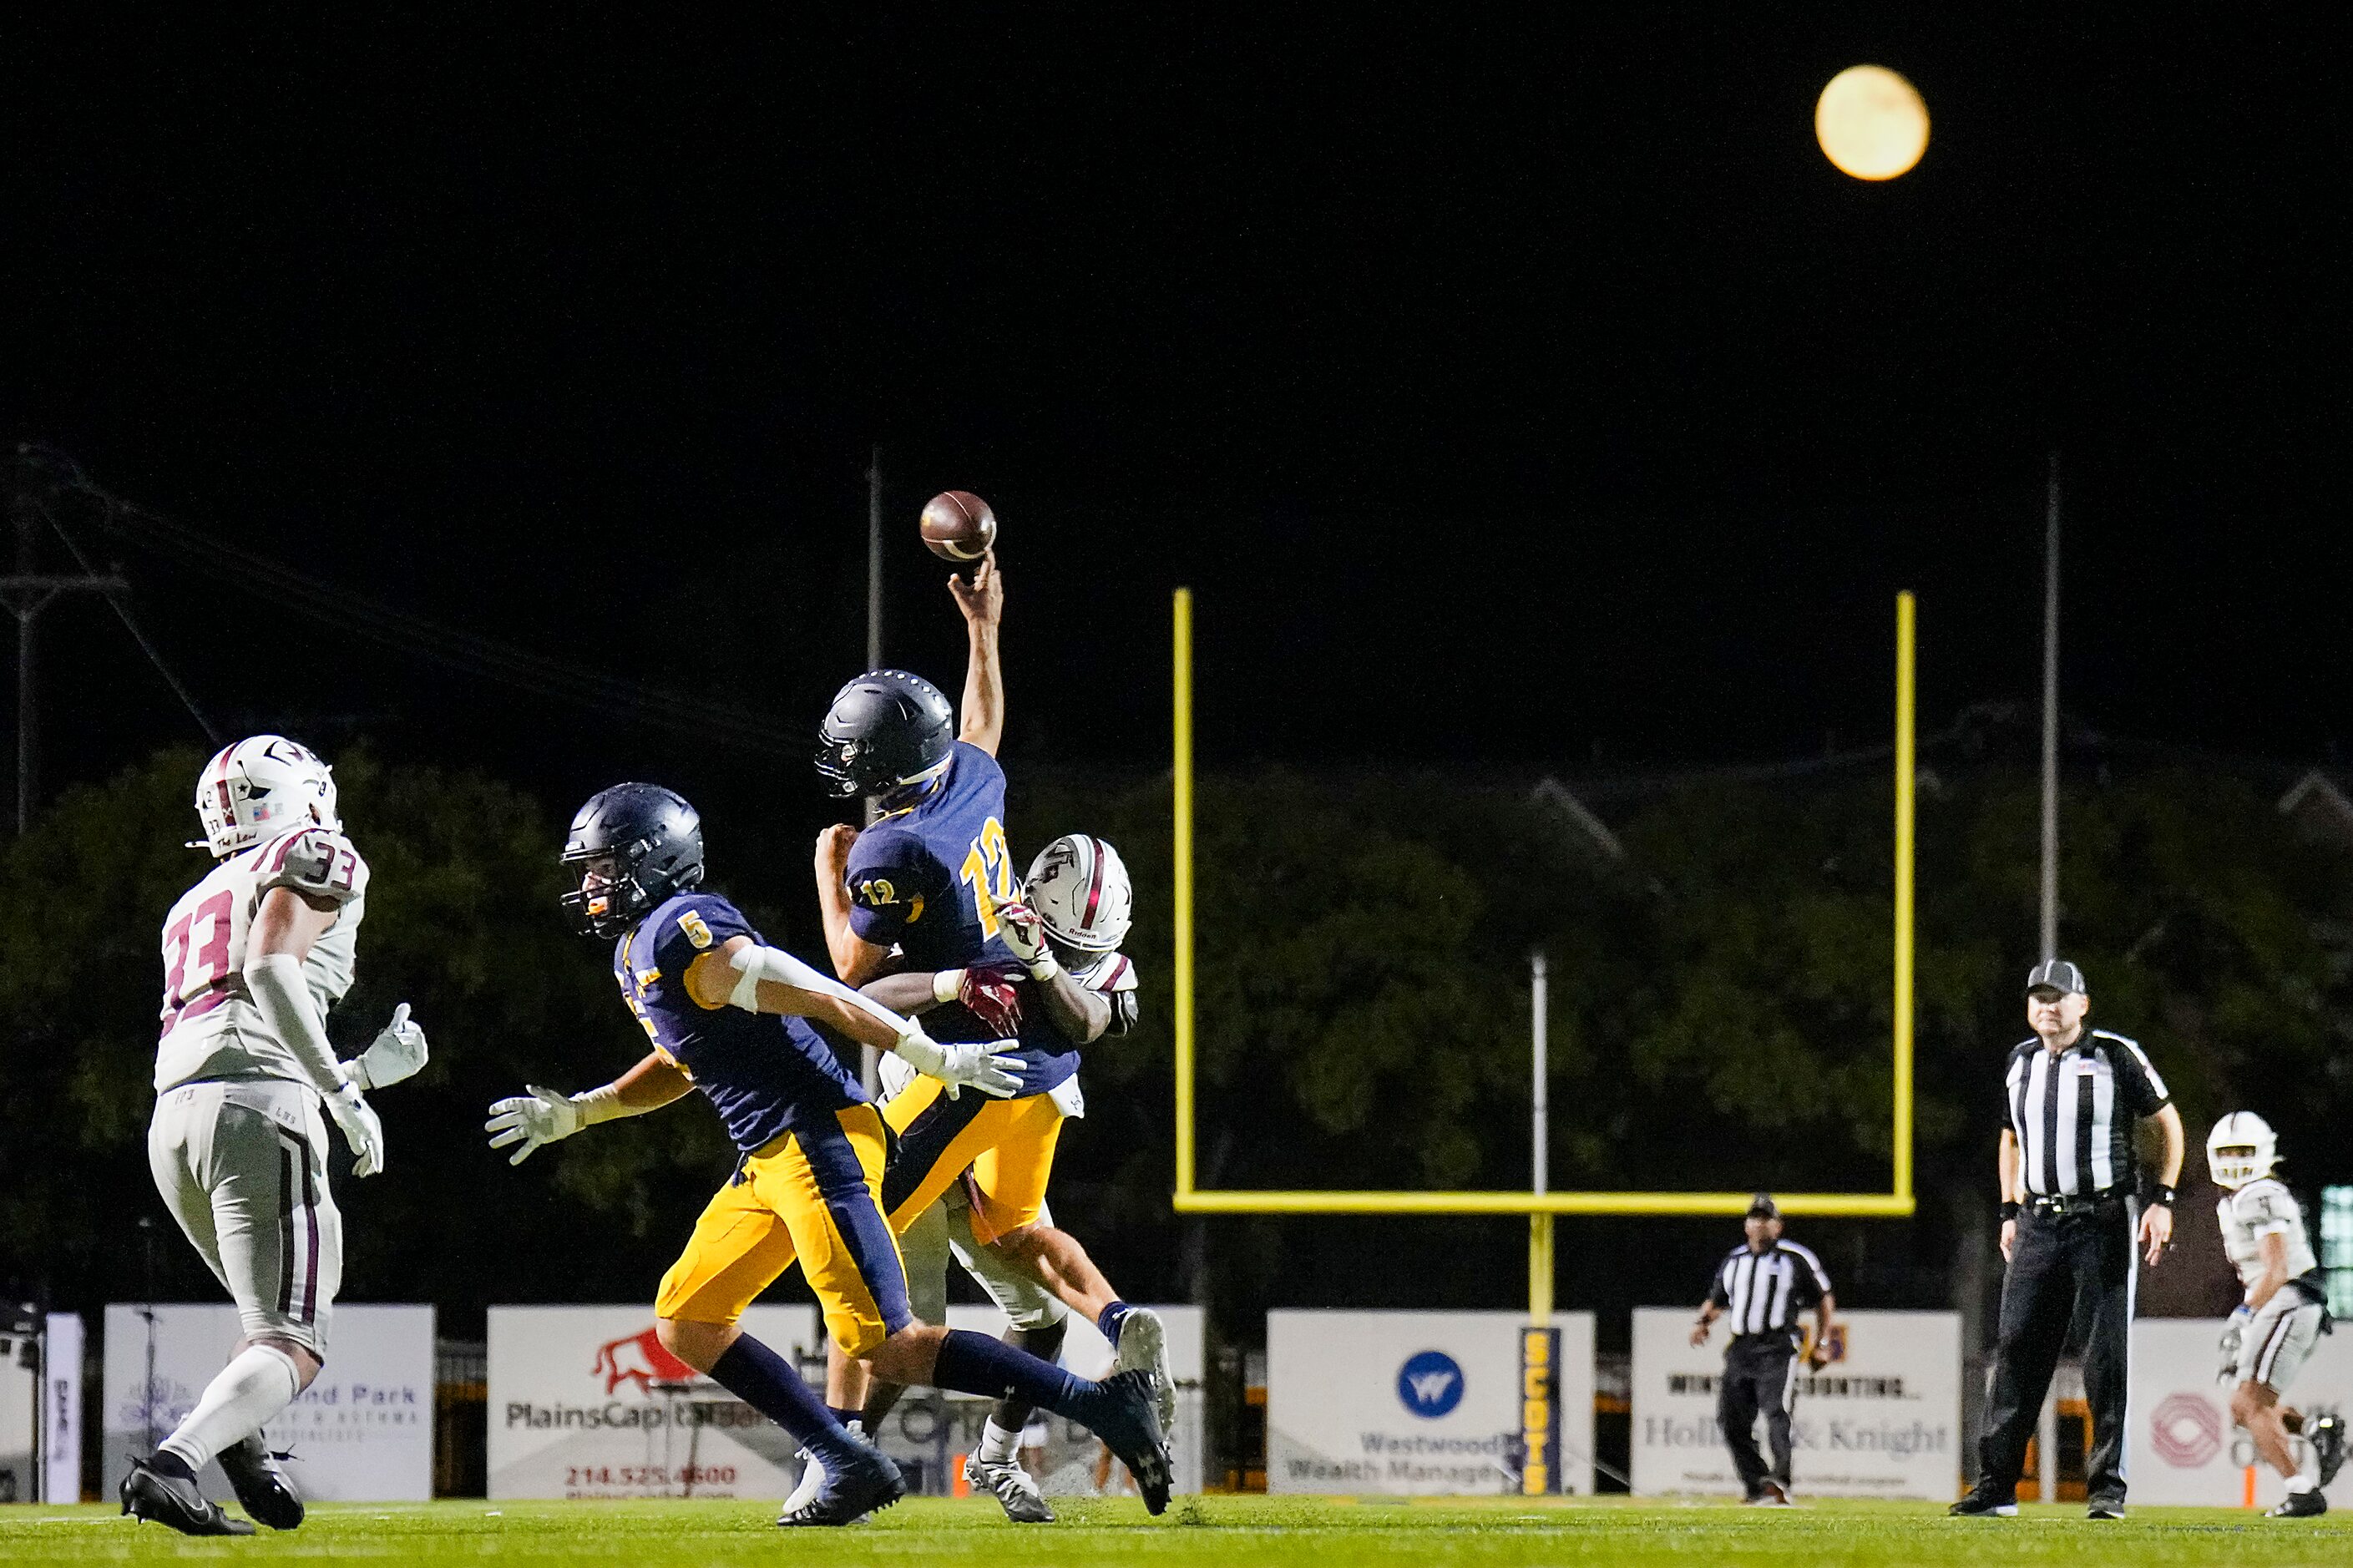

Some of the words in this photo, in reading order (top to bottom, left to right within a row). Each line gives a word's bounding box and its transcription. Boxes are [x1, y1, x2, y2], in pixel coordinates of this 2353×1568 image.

[306, 842, 357, 891] 33
[859, 878, 900, 906] 12
[676, 909, 713, 949] 5
[161, 889, 233, 1040] 33
[352, 1383, 416, 1405] Park
[1522, 1330, 1549, 1496] SCOTS
[1360, 1431, 1500, 1454] Westwood
[1645, 1417, 1718, 1447] Holl
[1829, 1419, 1947, 1459] Knight
[1287, 1459, 1379, 1480] Wealth
